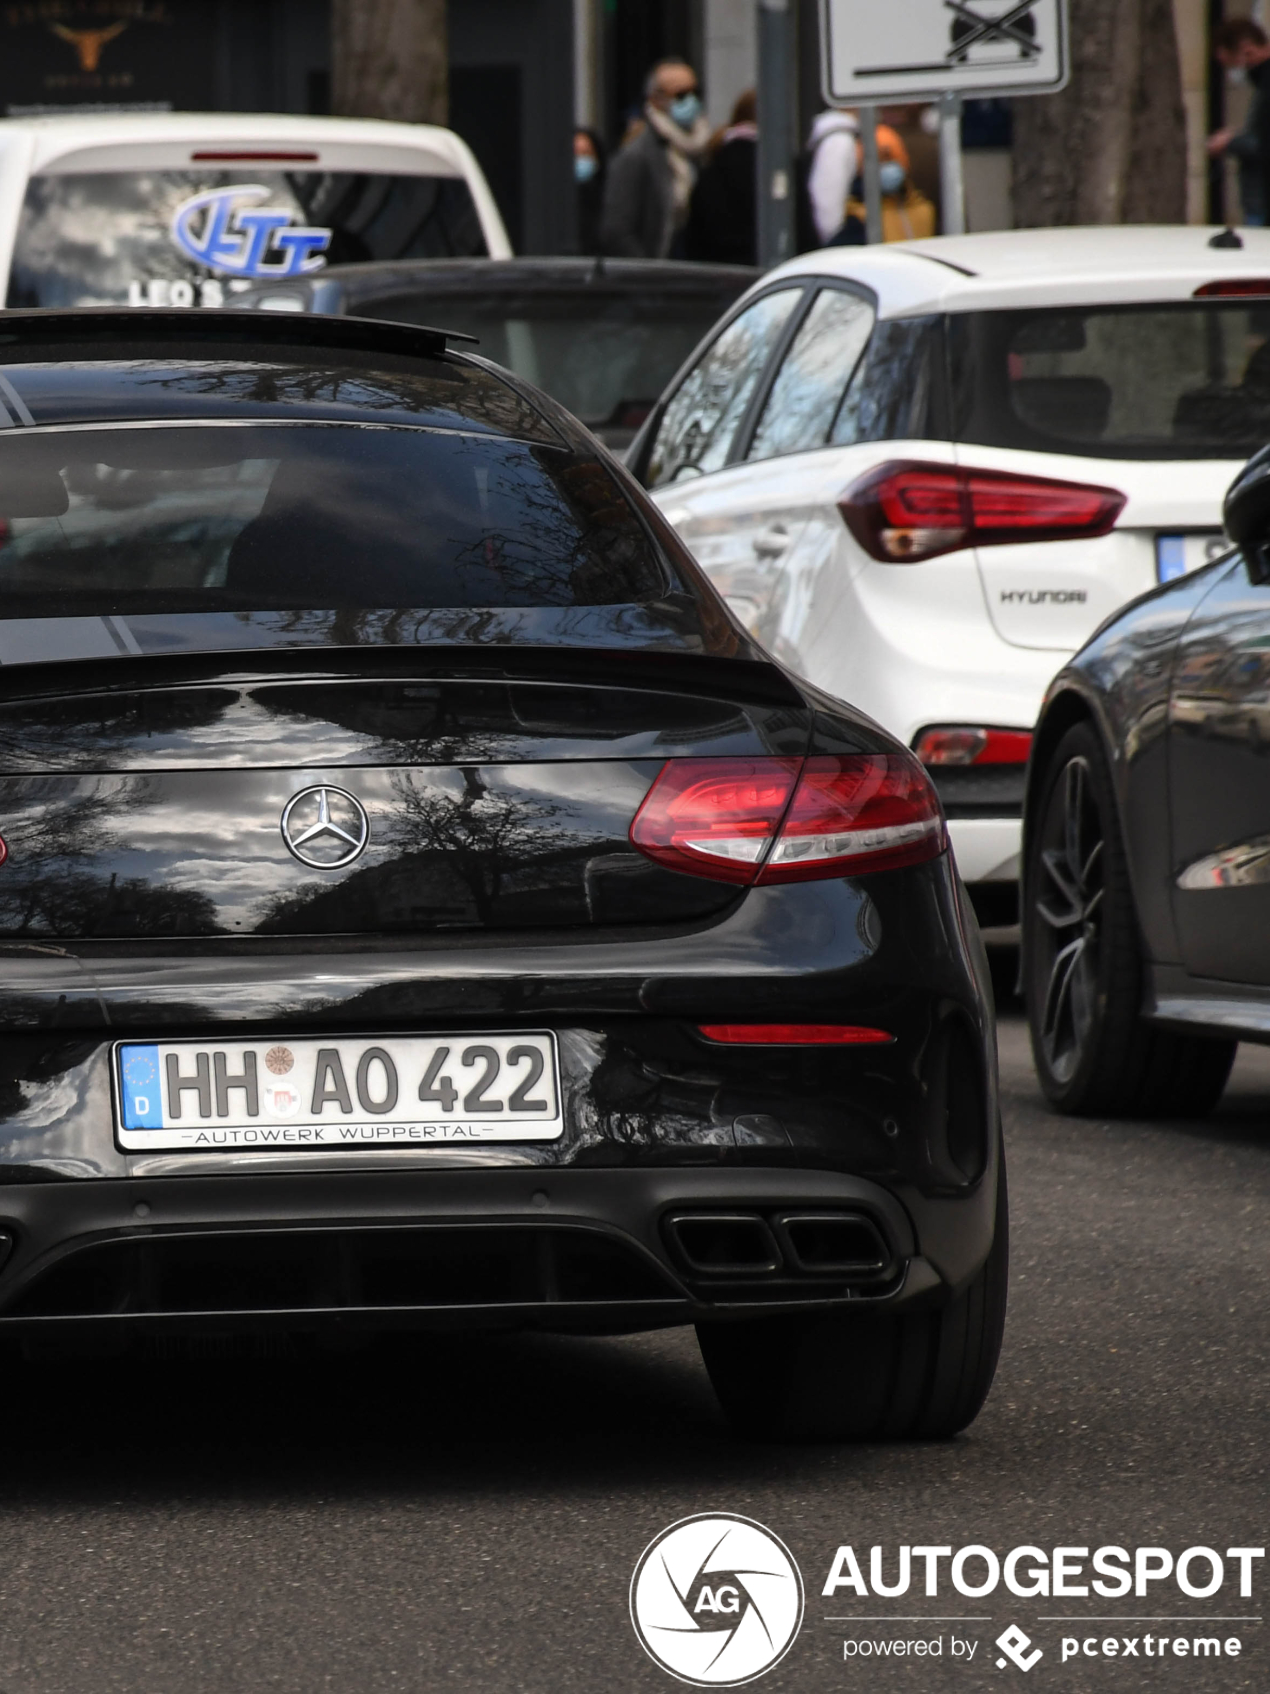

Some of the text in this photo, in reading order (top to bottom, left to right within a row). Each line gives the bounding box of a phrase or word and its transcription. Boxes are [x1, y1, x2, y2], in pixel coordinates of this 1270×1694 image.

[1000, 590, 1087, 604] HYUNDAI
[166, 1044, 548, 1119] HH AO 422
[134, 1096, 150, 1116] D
